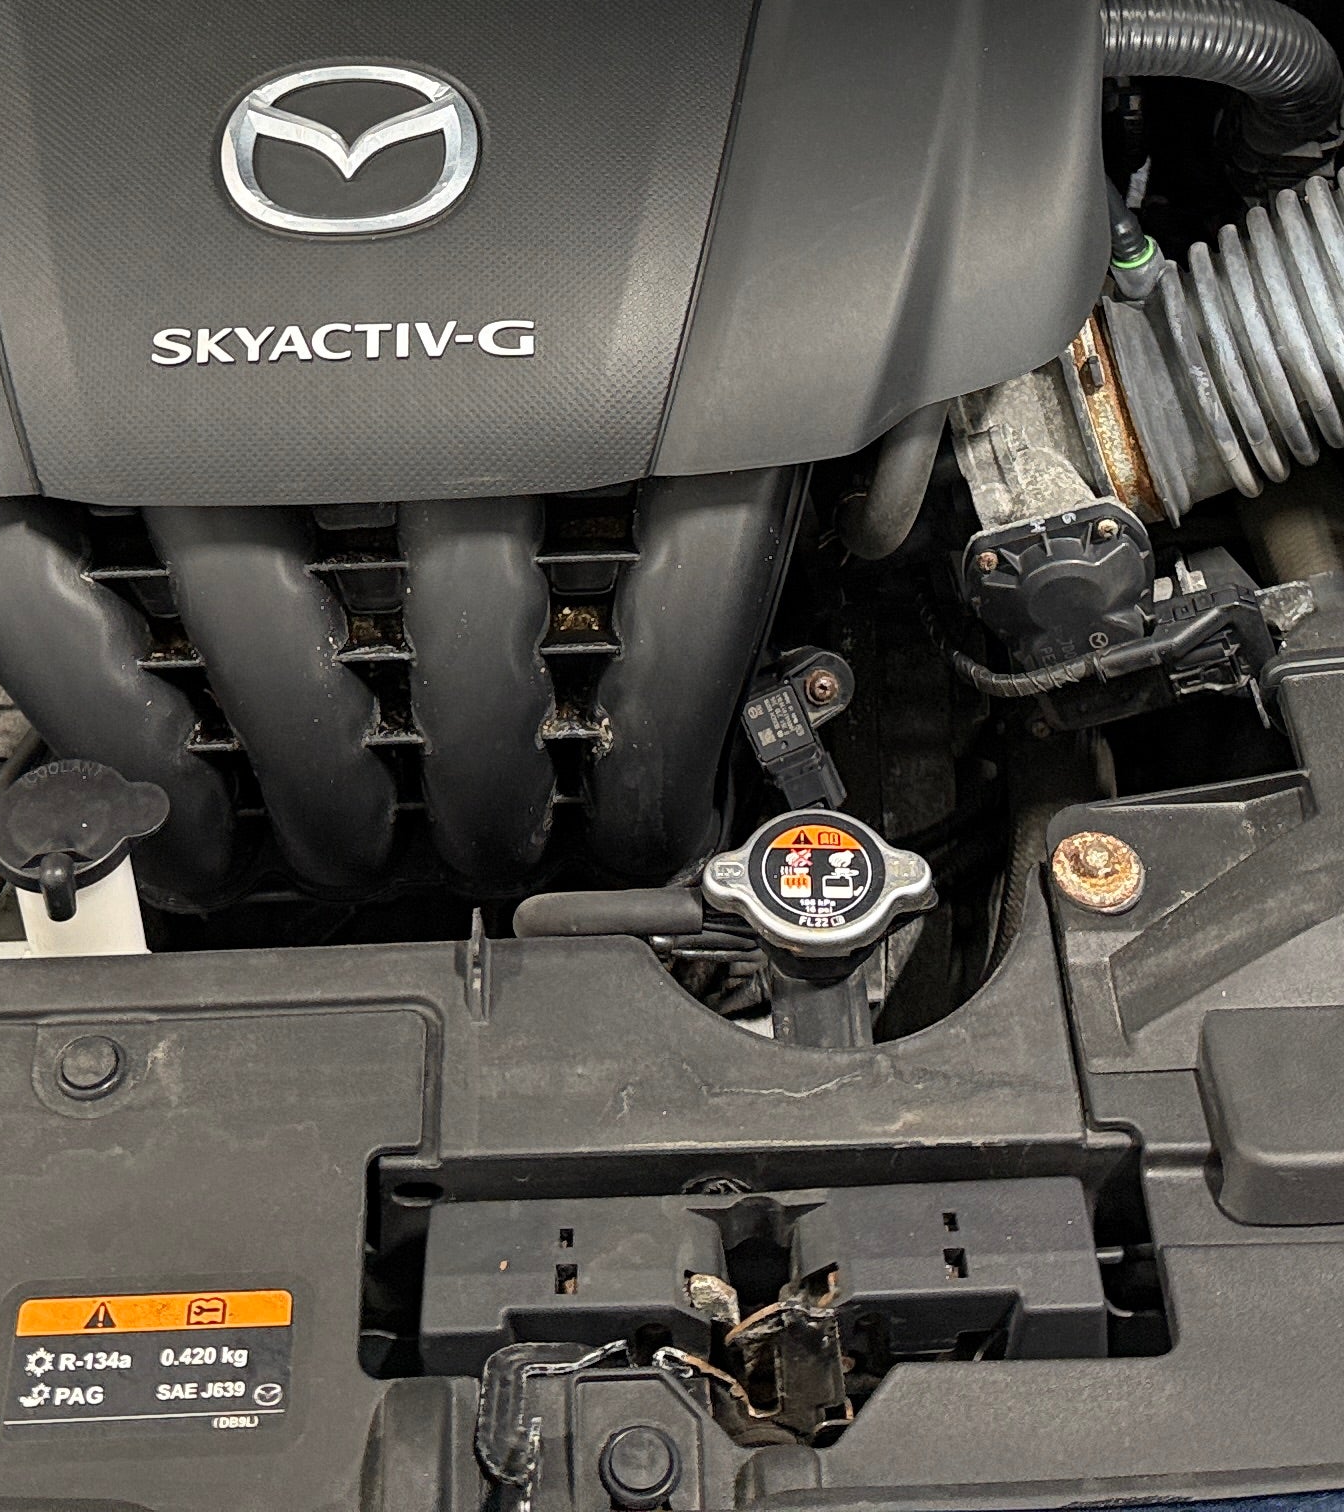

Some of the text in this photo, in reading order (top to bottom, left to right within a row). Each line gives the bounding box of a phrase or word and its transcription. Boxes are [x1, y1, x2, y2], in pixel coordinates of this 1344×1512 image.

[151, 319, 536, 365] SKYACTIV-G
[24, 759, 108, 784] COOLANT
[798, 915, 829, 927] FL22
[58, 1346, 249, 1371] R-134a 0.420 kg
[54, 1380, 246, 1406] PAG SAE J639
